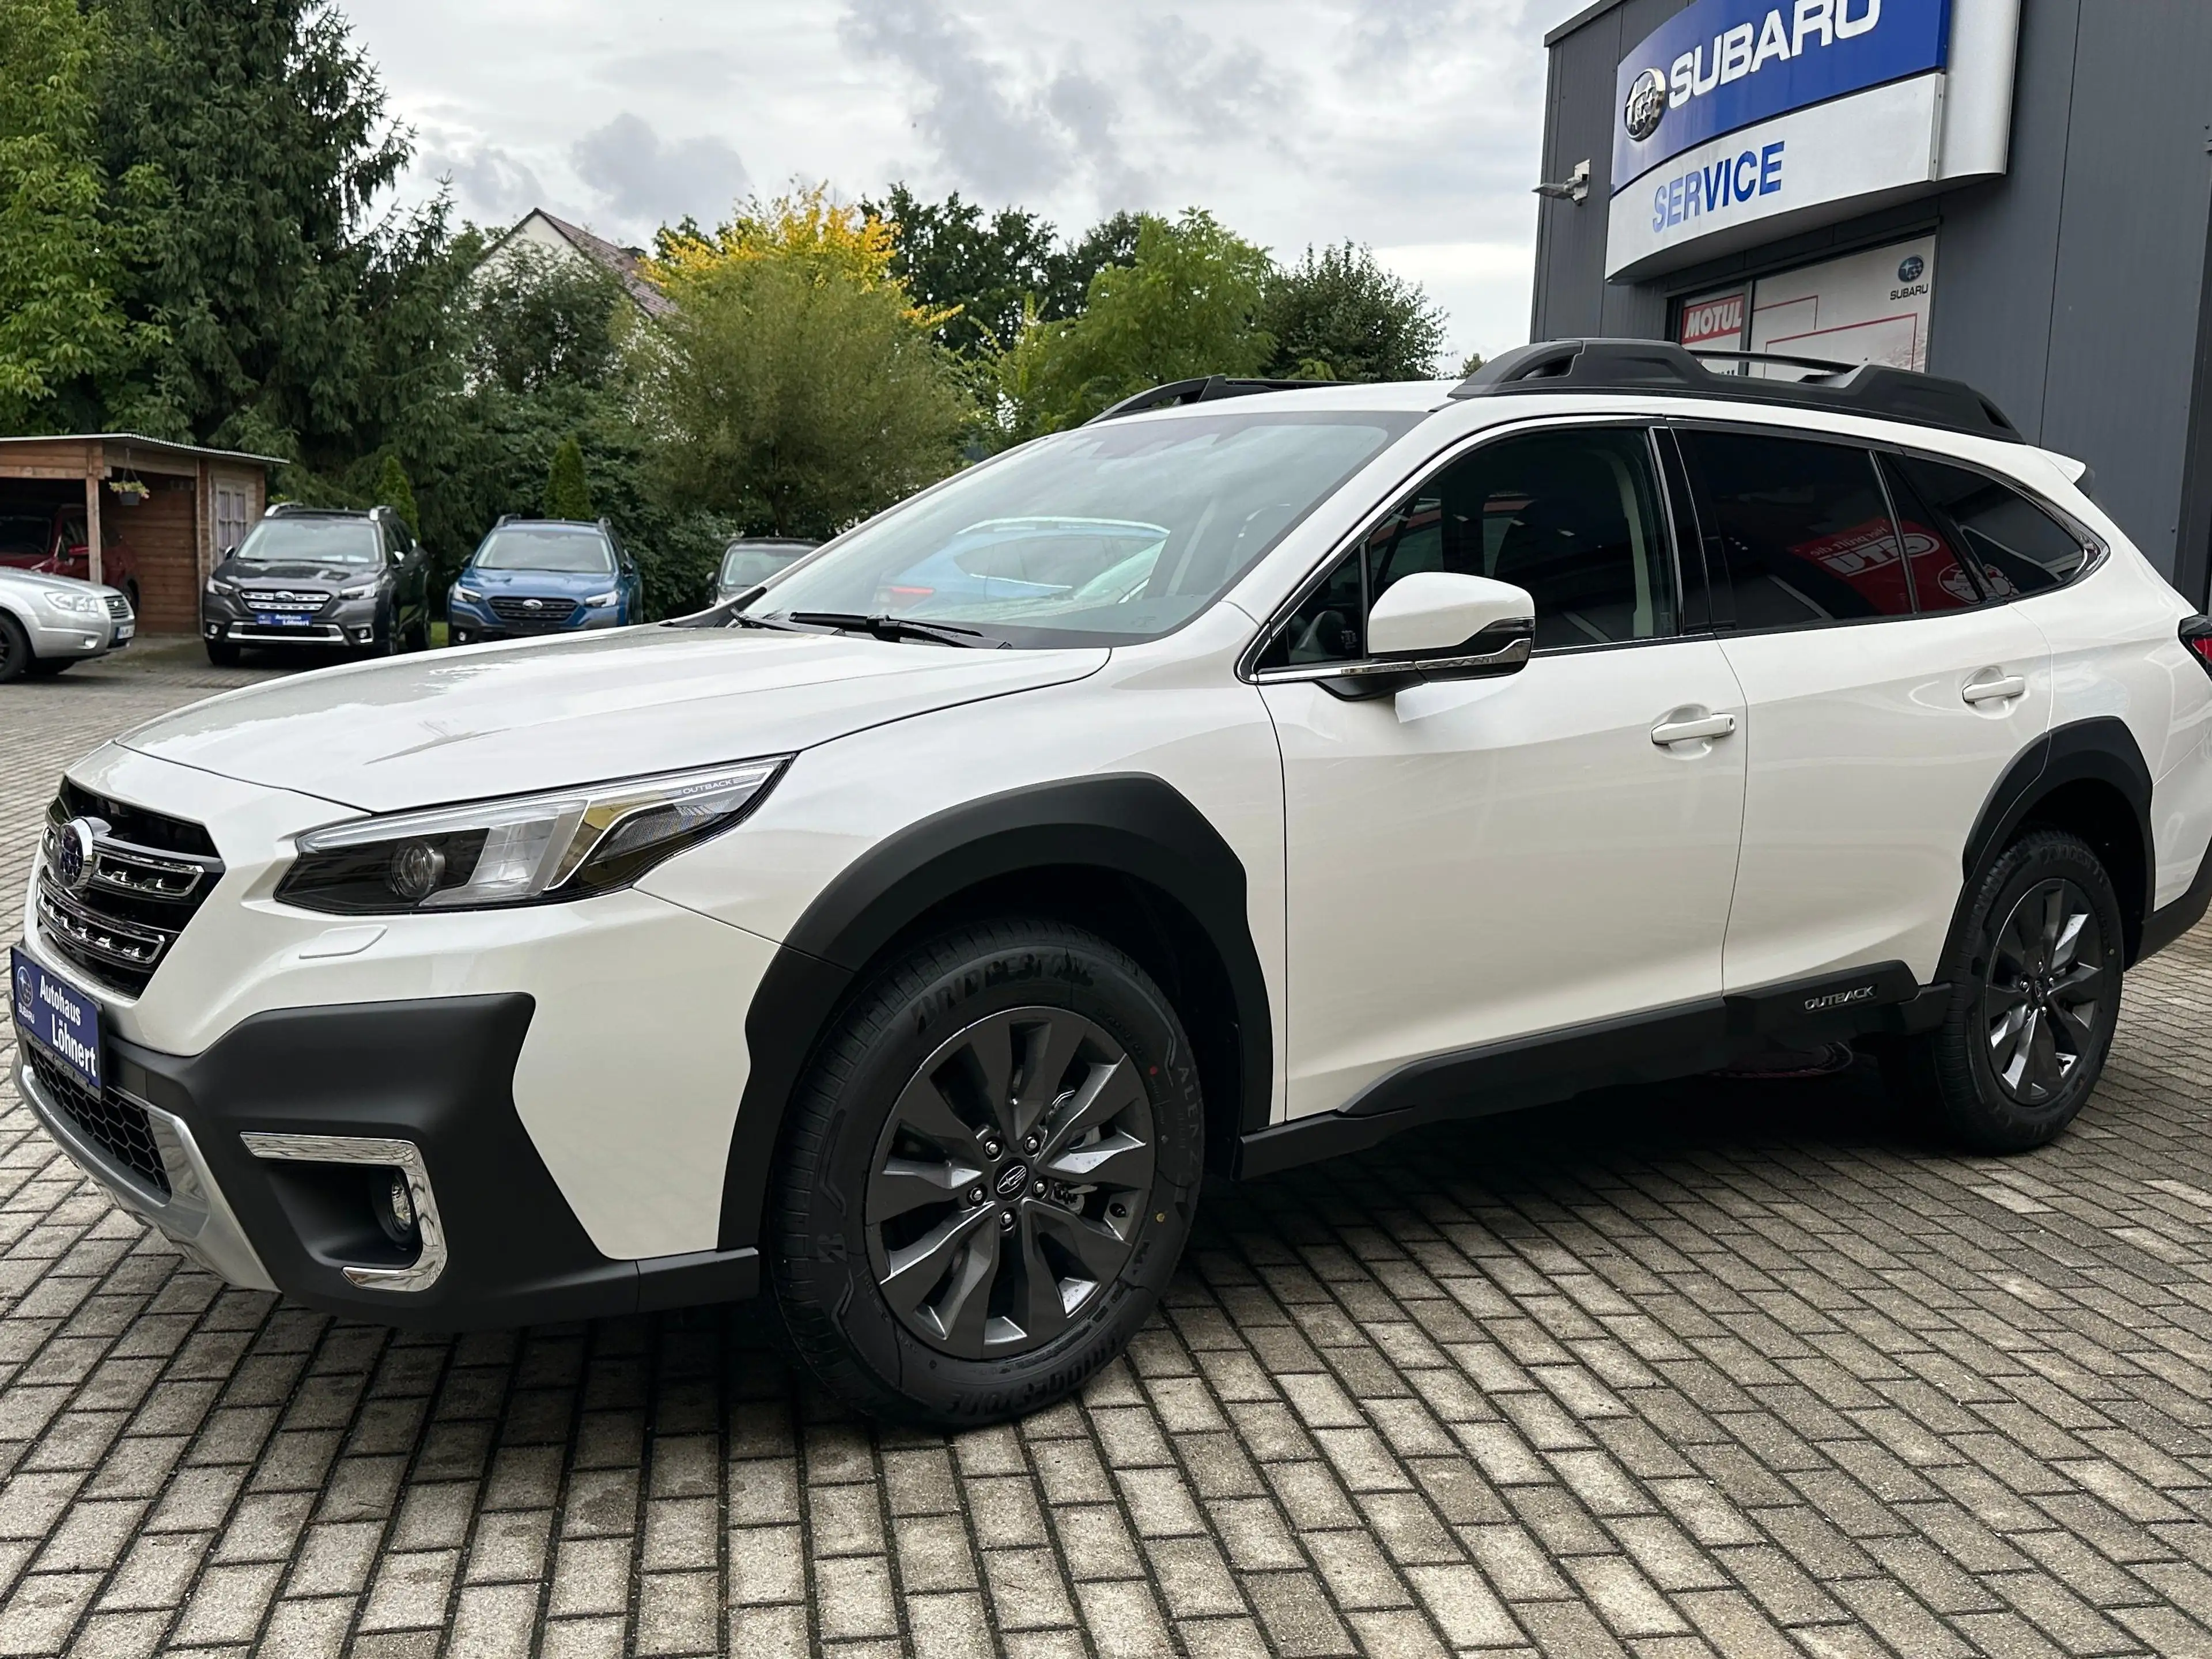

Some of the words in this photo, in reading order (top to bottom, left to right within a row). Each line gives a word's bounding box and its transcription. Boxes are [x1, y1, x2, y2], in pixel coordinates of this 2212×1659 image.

[1669, 0, 1881, 109] SUBARU
[1653, 141, 1785, 233] SERVICE
[1890, 283, 1929, 300] SUBARU
[1684, 301, 1742, 339] MOTUL
[683, 779, 733, 794] OUTBACK
[40, 975, 81, 1027] Autohaus
[1805, 986, 1874, 1010] OUTBACK
[51, 1013, 96, 1078] Löhnert
[1177, 1067, 1200, 1178] ALENZ
